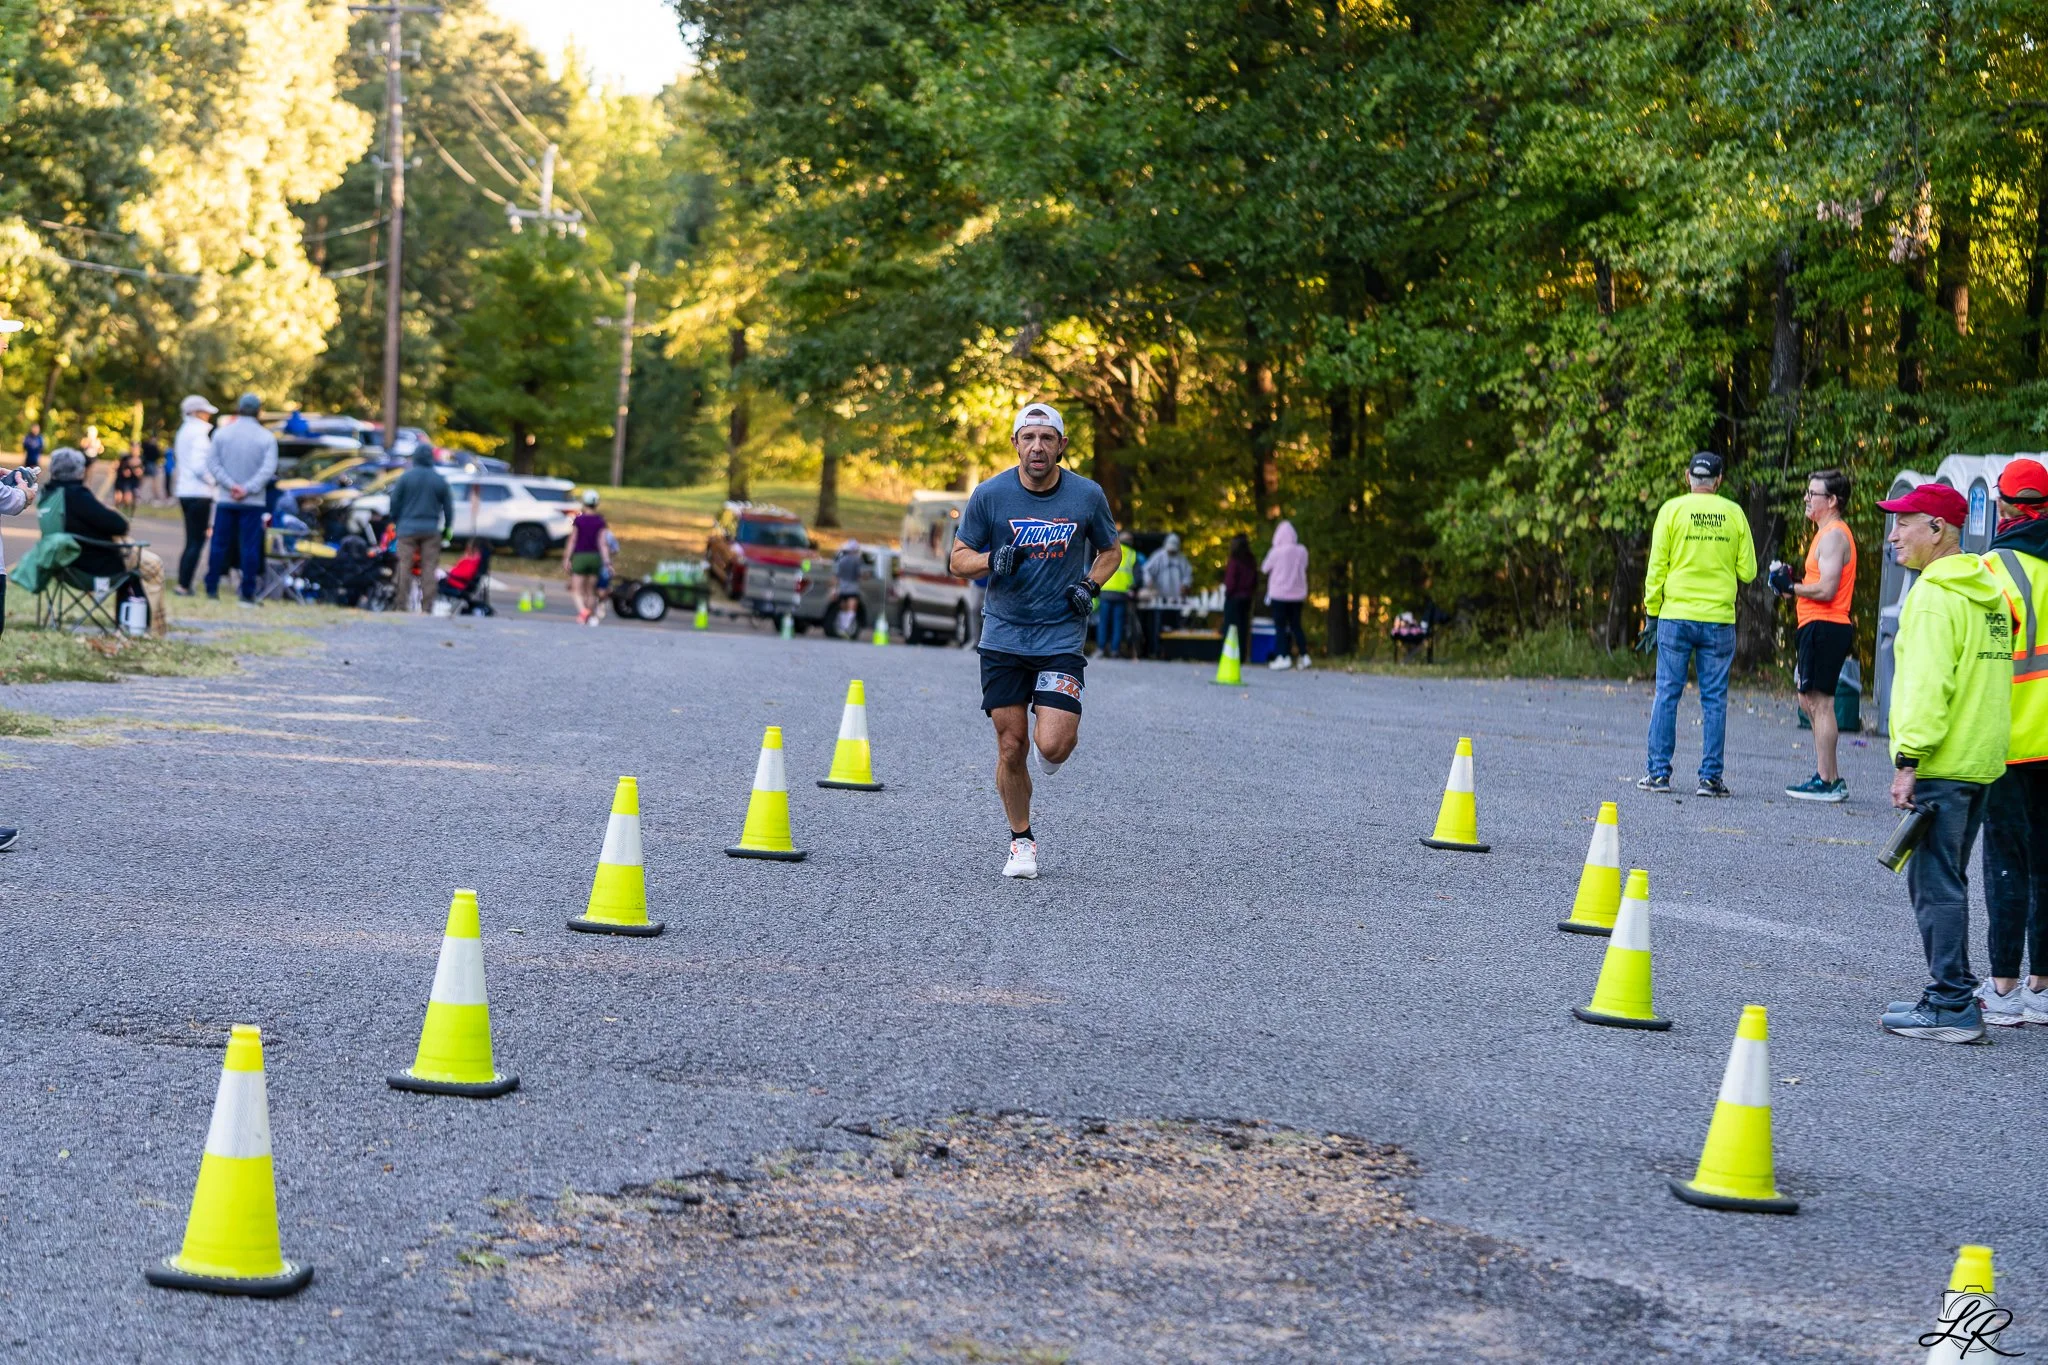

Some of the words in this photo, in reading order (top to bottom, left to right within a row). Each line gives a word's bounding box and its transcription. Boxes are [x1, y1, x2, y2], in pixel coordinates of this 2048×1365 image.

[1691, 513, 1726, 521] MEMPHIS
[1008, 517, 1078, 551] THUNDER
[1029, 551, 1064, 559] ACING
[1053, 680, 1080, 700] 246
